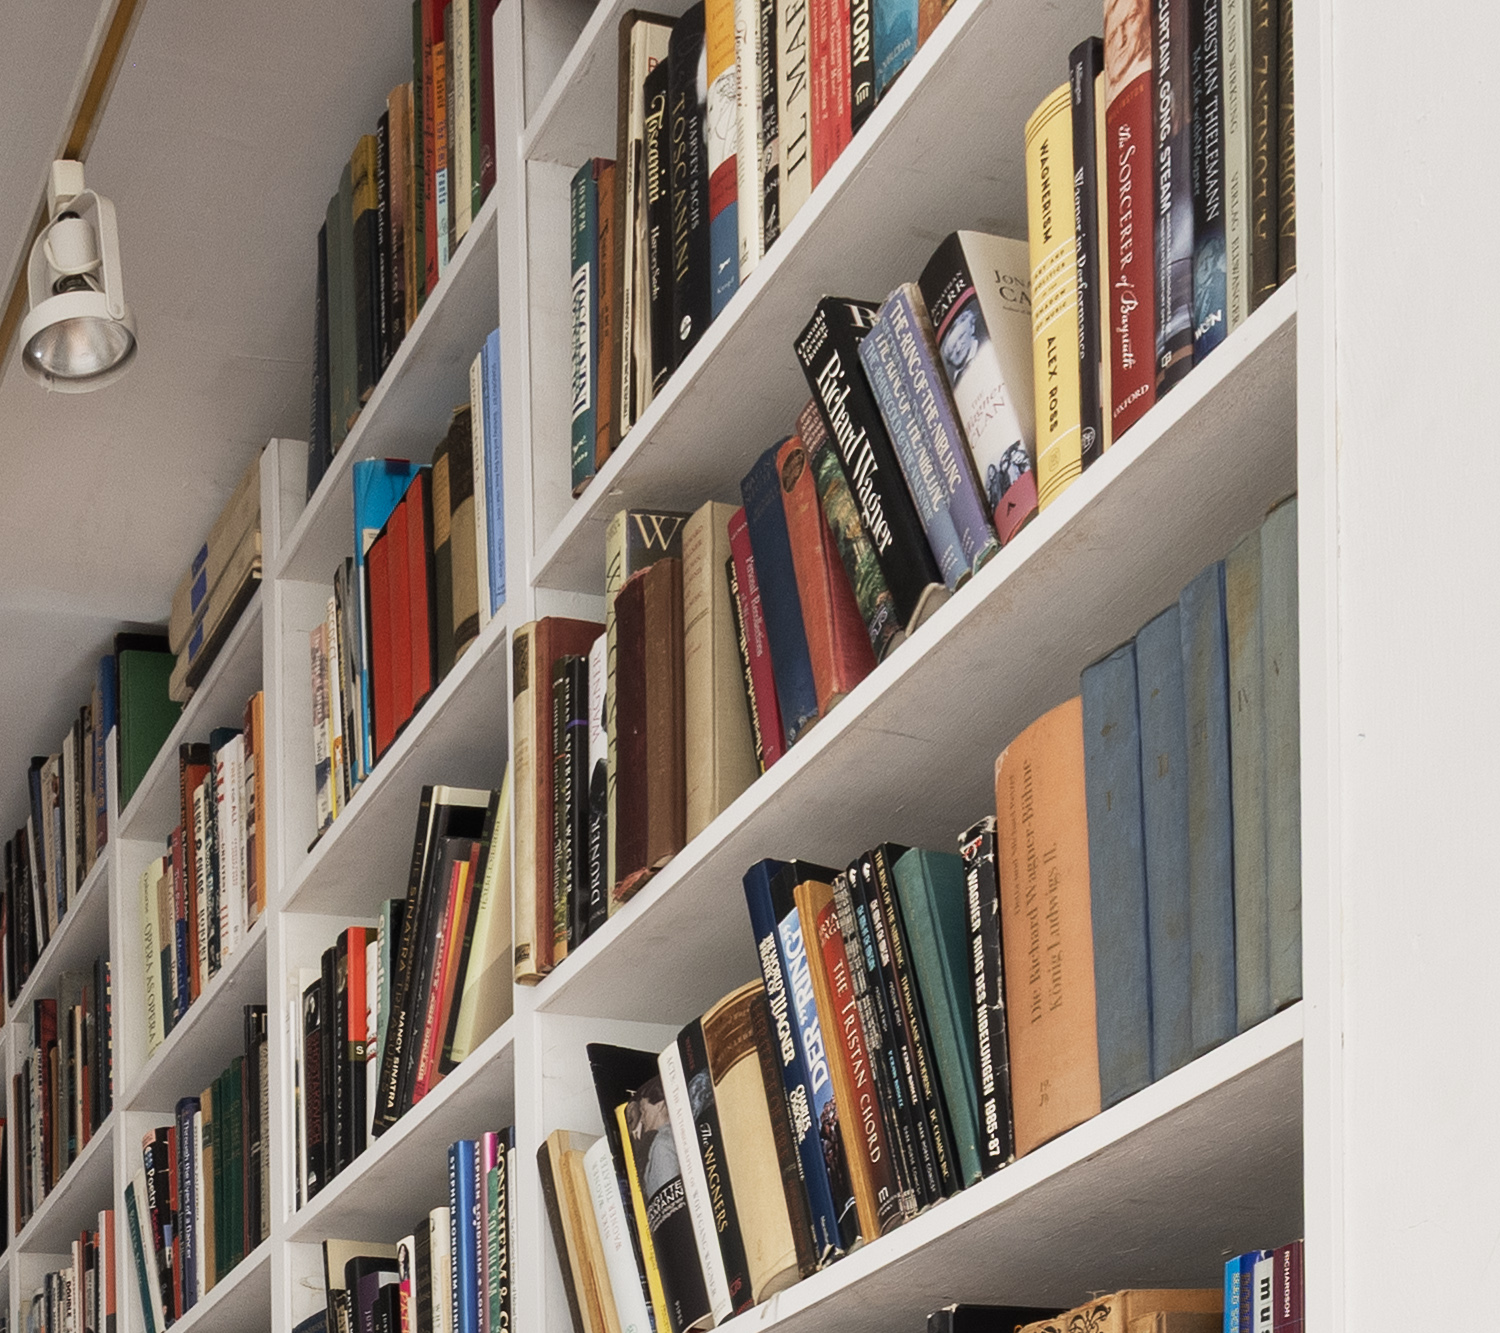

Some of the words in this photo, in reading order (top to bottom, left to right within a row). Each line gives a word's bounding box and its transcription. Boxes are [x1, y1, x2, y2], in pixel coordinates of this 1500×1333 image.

[1038, 137, 1055, 245] WAGNERISM
[1044, 335, 1061, 380] ALEX
[1047, 386, 1059, 433] ROSS
[816, 349, 865, 466] Richard
[849, 441, 894, 554] Wagner
[966, 869, 981, 933] WAGNER
[971, 935, 983, 973] RING
[974, 977, 985, 999] DES
[976, 1000, 996, 1096] NIBELUNGEN
